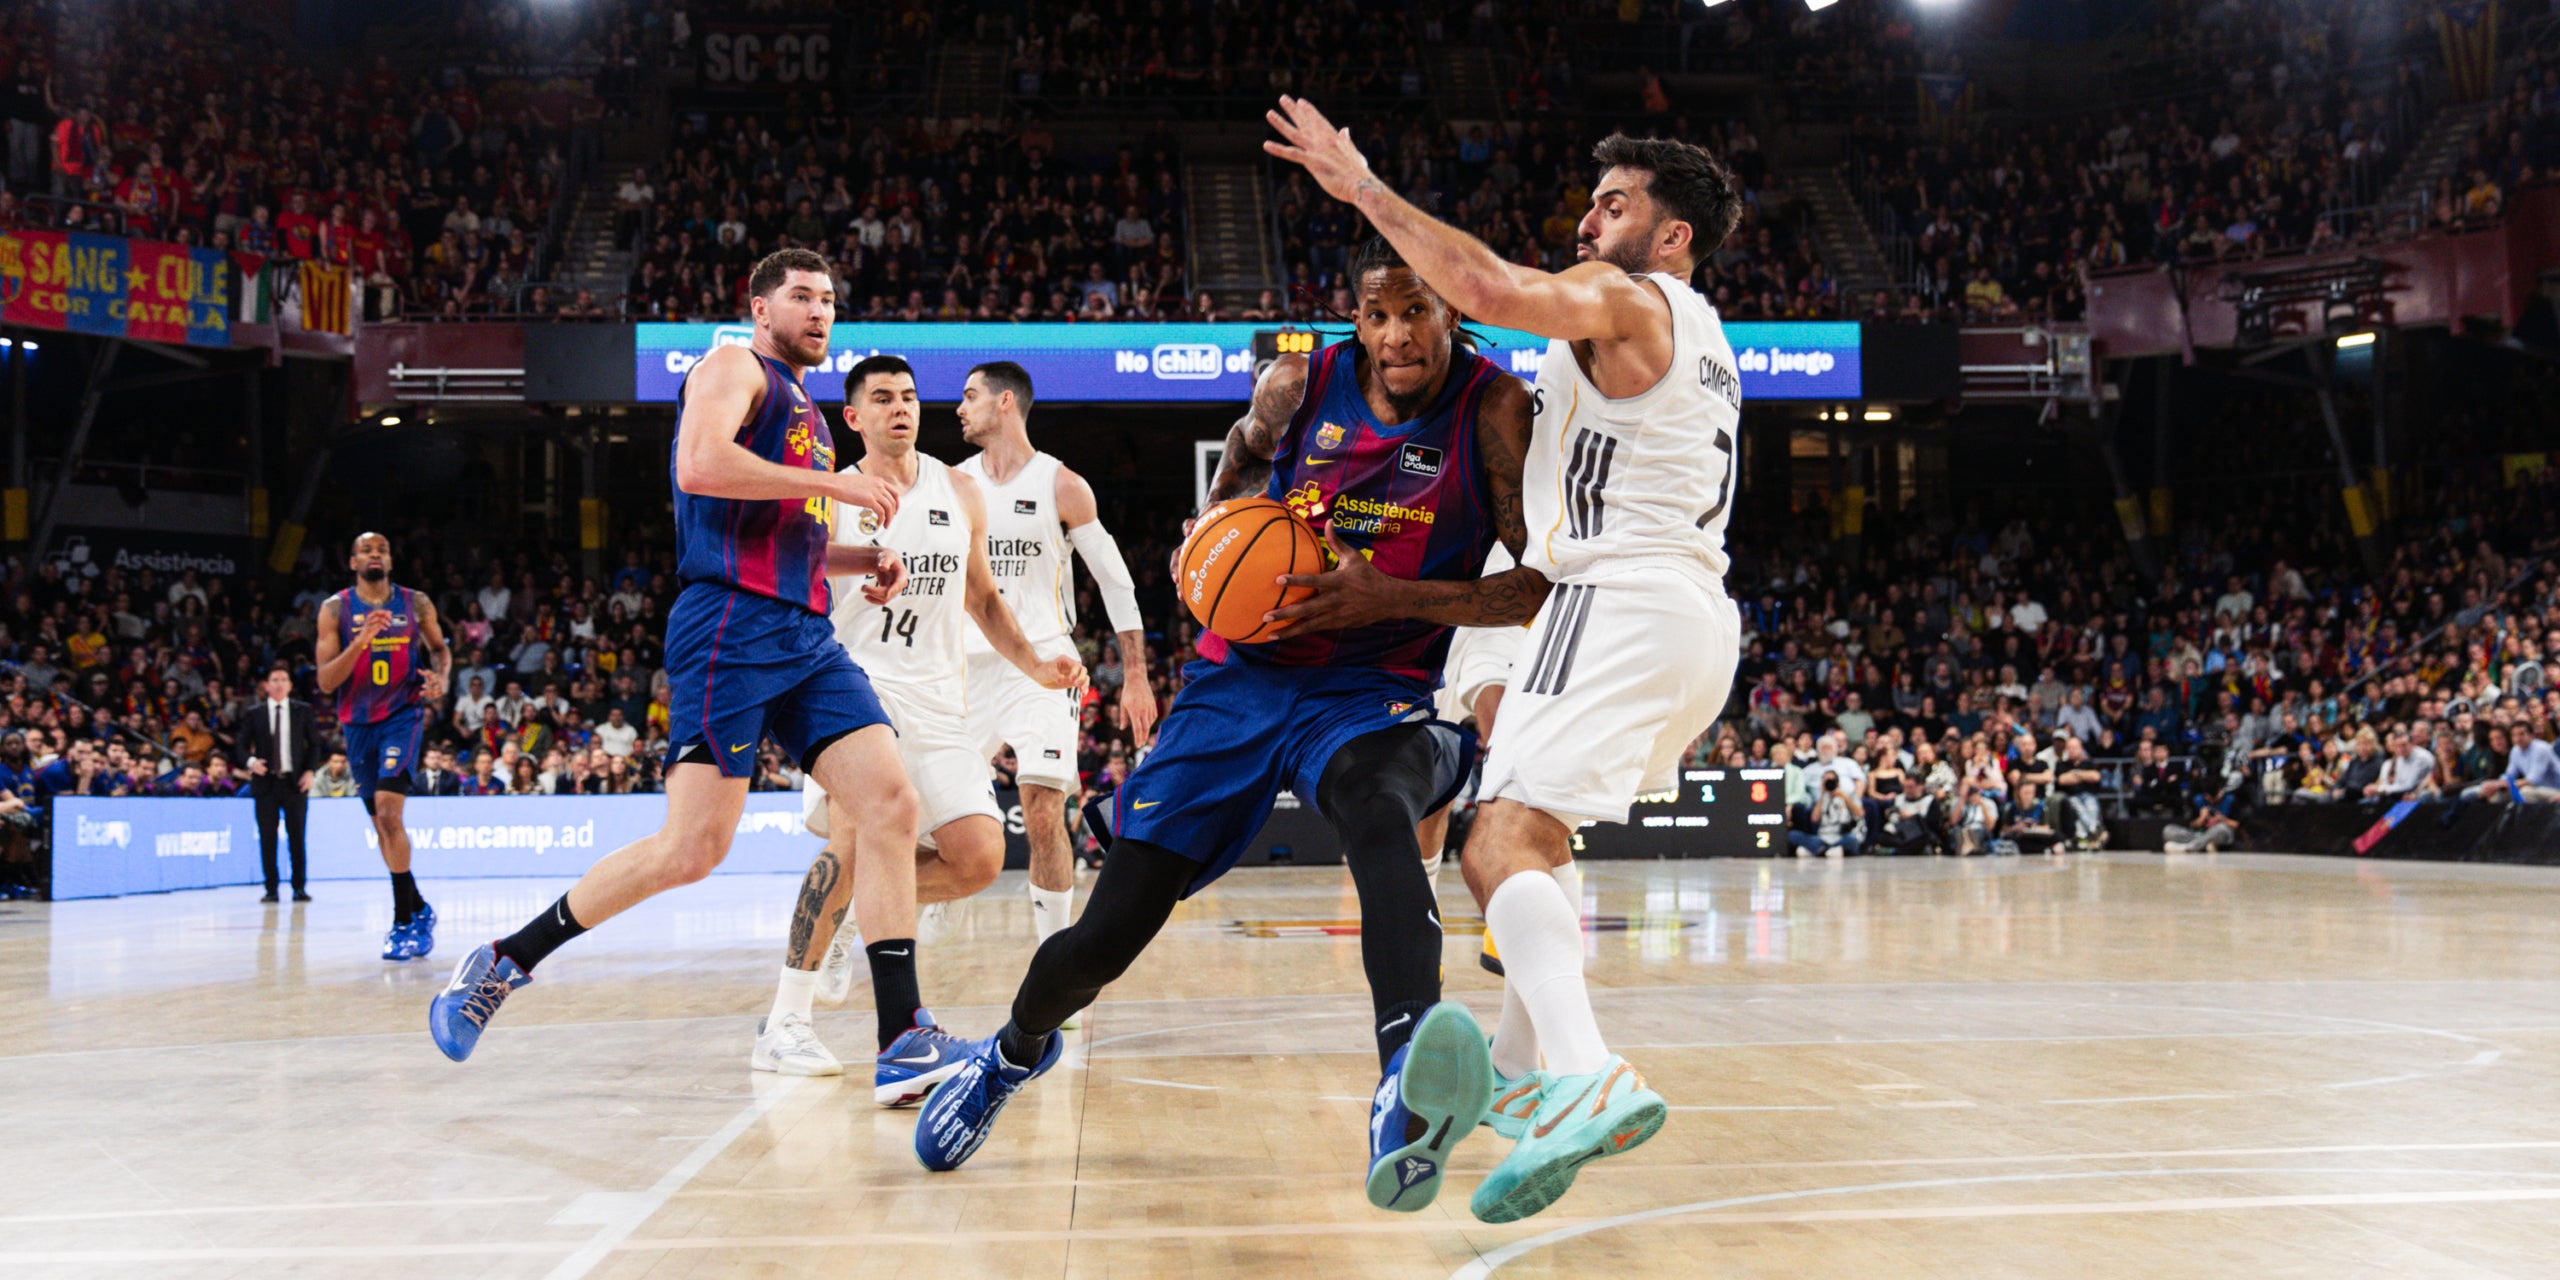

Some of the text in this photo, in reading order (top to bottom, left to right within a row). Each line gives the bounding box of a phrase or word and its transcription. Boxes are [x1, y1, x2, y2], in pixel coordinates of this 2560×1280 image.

[30, 241, 117, 293] SANG
[30, 290, 90, 315] COR
[1116, 350, 1149, 373] No
[1158, 350, 1217, 373] child
[1739, 347, 1769, 371] de
[1770, 347, 1834, 376] juego
[1404, 461, 1437, 473] endesa
[1405, 452, 1421, 462] liga
[1695, 428, 1732, 530] 7
[1334, 494, 1435, 524] Assistència
[1333, 511, 1401, 534] Sanitària
[988, 535, 1042, 557] irates
[1199, 528, 1241, 580] endesa
[902, 551, 960, 574] irates
[881, 606, 919, 648] 14
[372, 660, 389, 686] 0
[364, 818, 594, 855] ww.encamp.ad
